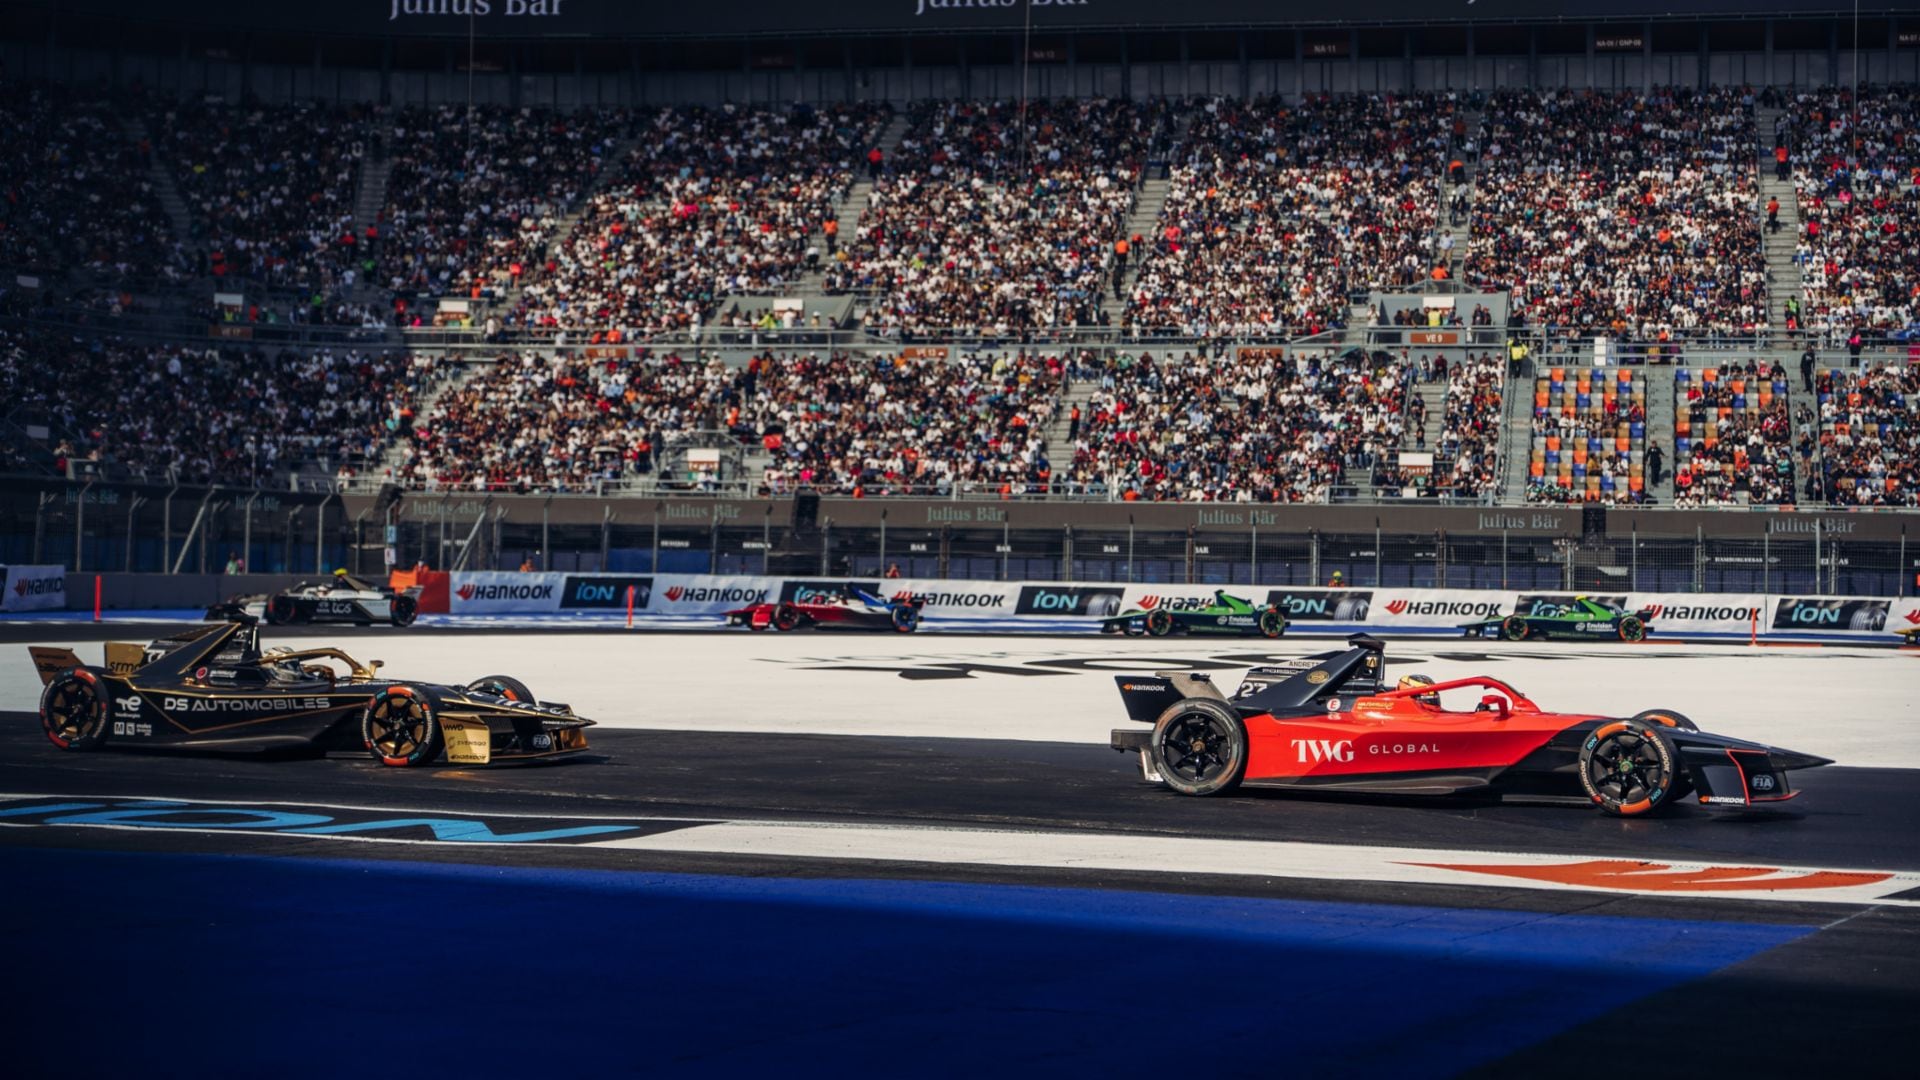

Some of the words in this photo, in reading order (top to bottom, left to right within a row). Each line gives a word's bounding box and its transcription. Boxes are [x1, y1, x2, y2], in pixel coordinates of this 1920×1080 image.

[1425, 334, 1436, 342] VE
[1437, 334, 1443, 342] 9
[666, 504, 708, 519] Julius
[714, 504, 742, 518] Bär
[927, 506, 971, 522] Julius
[977, 506, 1005, 521] Bär
[1198, 510, 1243, 525] Julius
[1249, 510, 1278, 524] Bär
[1479, 513, 1526, 530] Julius
[1531, 514, 1561, 529] Bär
[1769, 518, 1816, 534] Julius
[1824, 518, 1856, 533] Bär
[1241, 682, 1268, 698] 27
[164, 697, 189, 711] DS
[191, 697, 330, 711] AUTOMOBILES
[1291, 739, 1354, 762] TWG
[1369, 744, 1440, 754] GLOBAL
[1753, 777, 1773, 788] FIA
